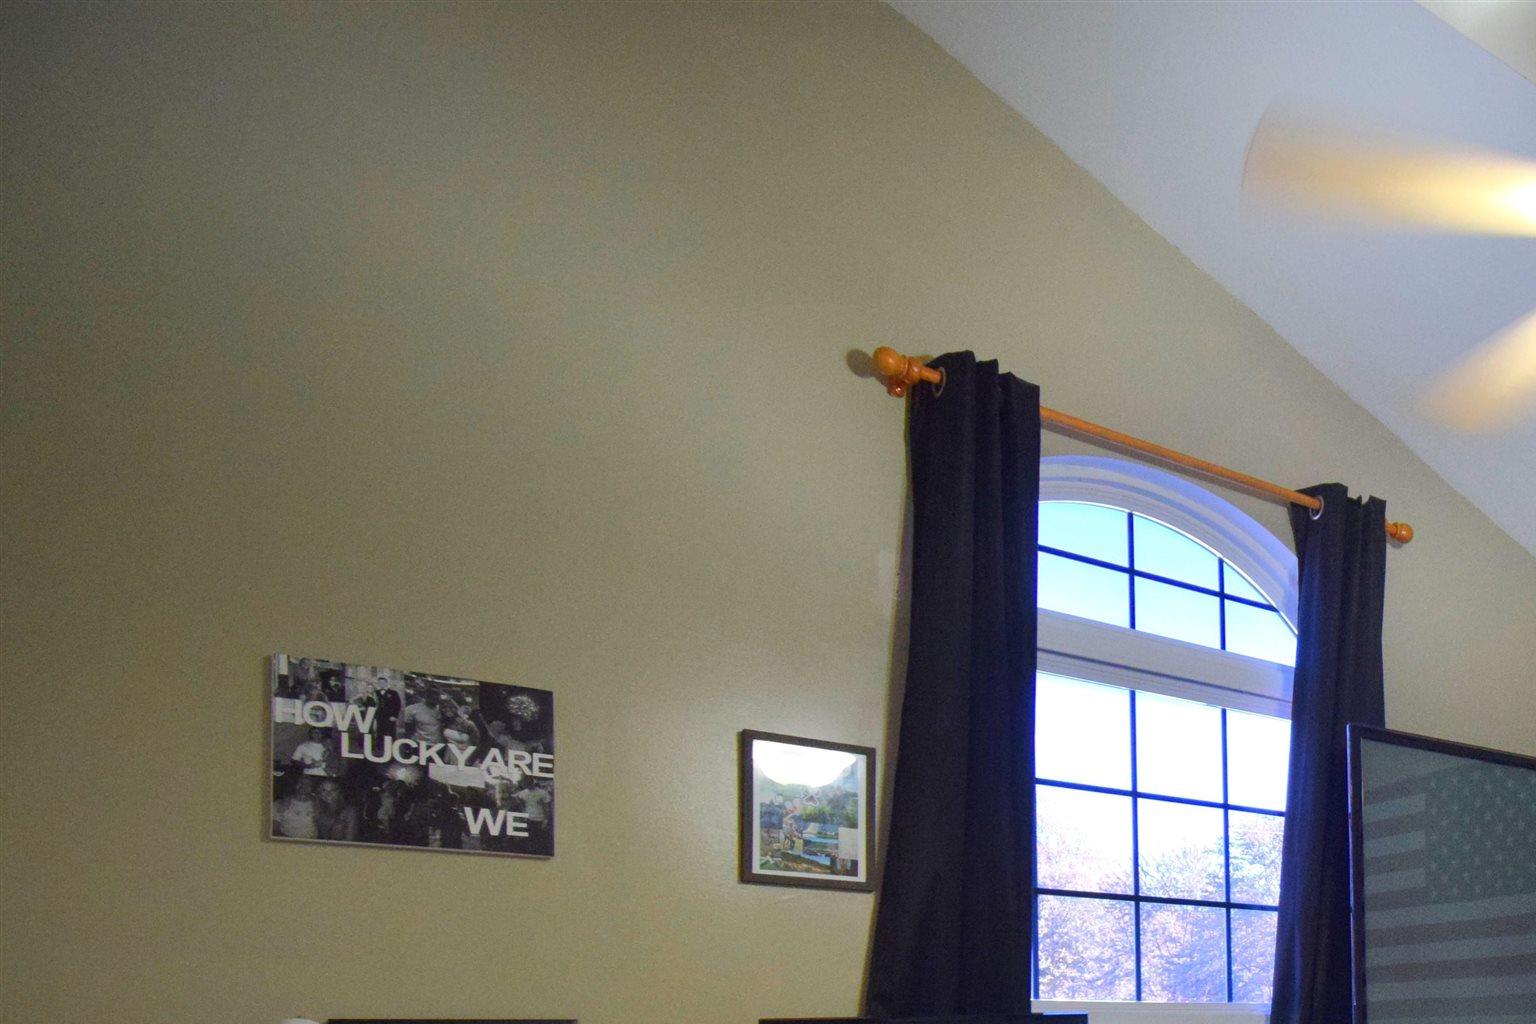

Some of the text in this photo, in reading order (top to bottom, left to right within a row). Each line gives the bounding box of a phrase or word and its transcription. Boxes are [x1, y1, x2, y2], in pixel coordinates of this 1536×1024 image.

[273, 697, 376, 733] HOW
[340, 732, 554, 778] LUCKY ARE
[463, 806, 530, 838] WE
